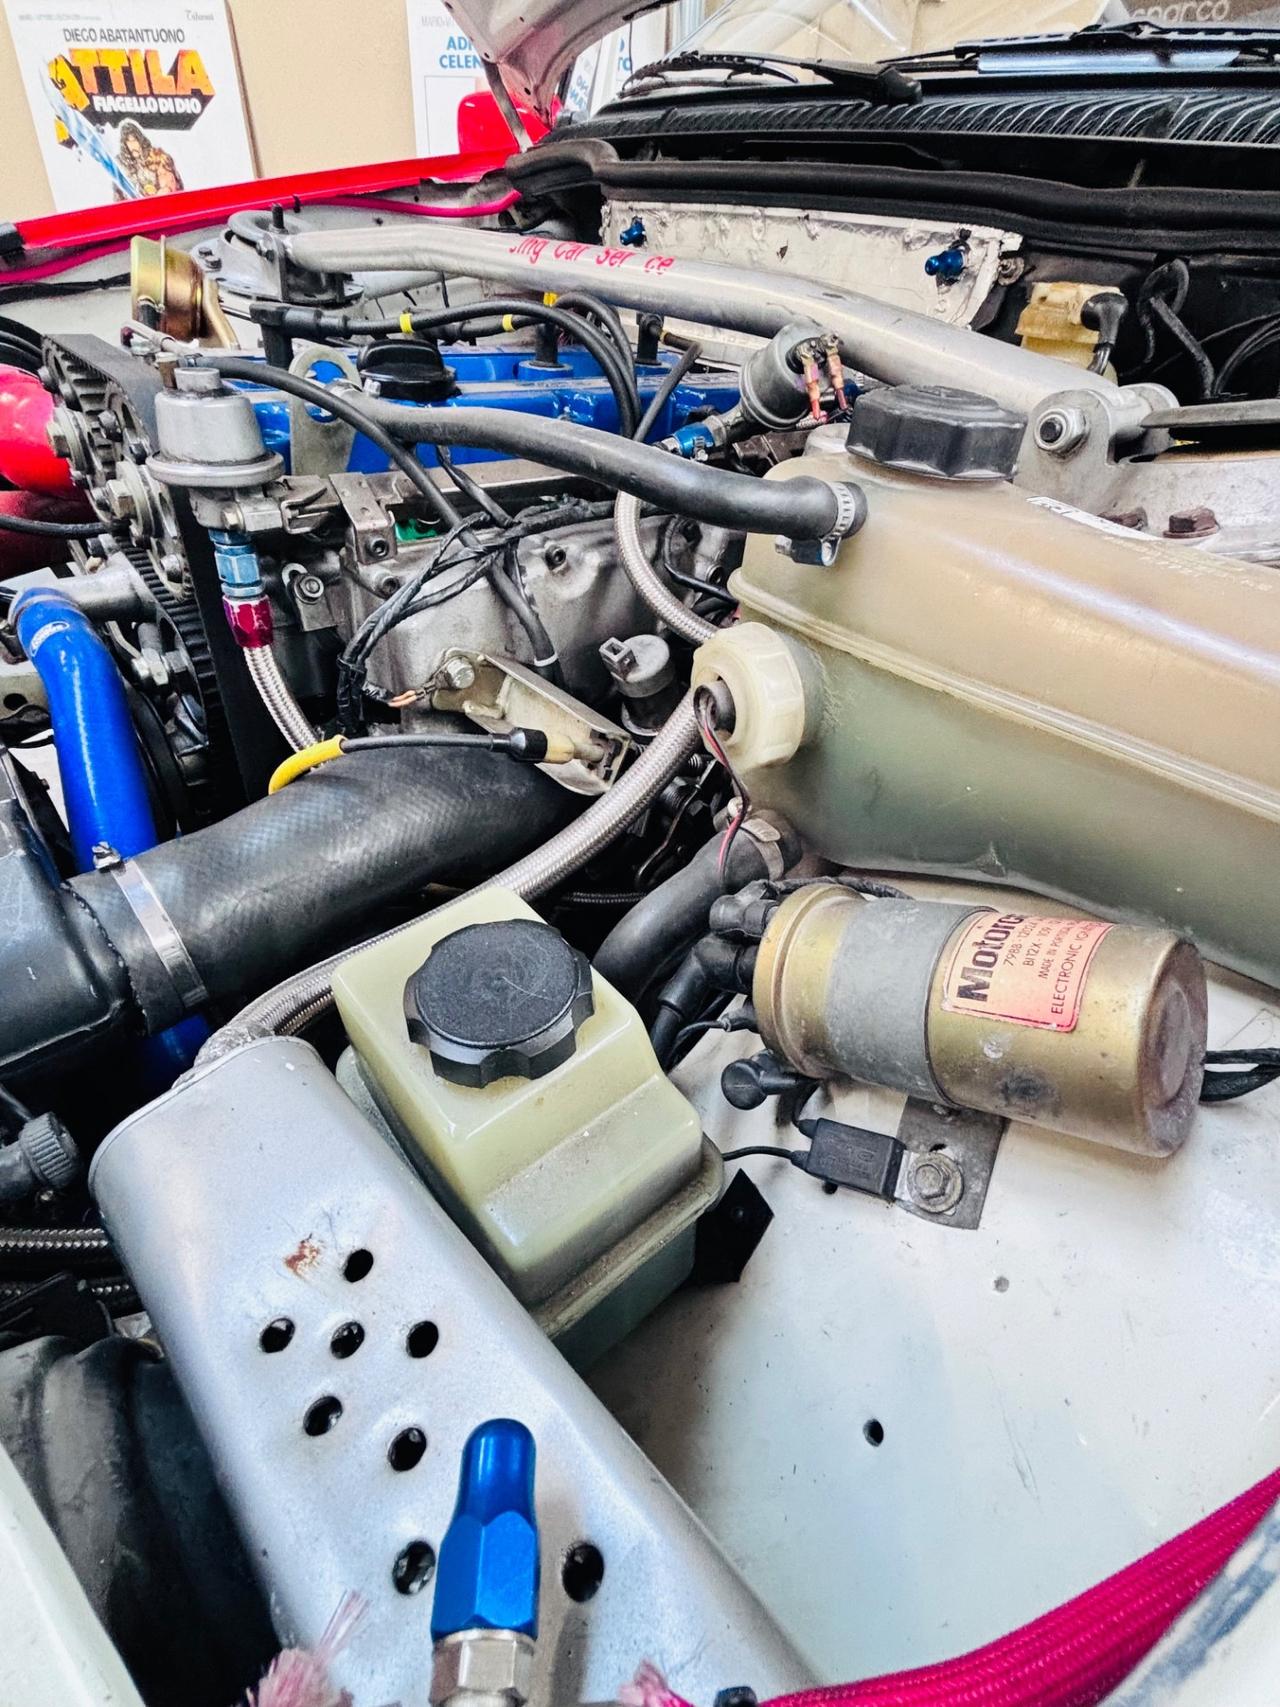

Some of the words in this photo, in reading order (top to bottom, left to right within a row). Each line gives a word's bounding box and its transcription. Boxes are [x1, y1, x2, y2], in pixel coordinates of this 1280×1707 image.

[63, 28, 97, 42] DIEGO
[99, 28, 185, 43] ABATANTUONO
[47, 48, 216, 112] ATTILA
[92, 95, 158, 114] FLAGELLO
[158, 97, 176, 113] DI
[176, 97, 202, 114] DIO
[1051, 943, 1082, 1015] ELECTRONIC
